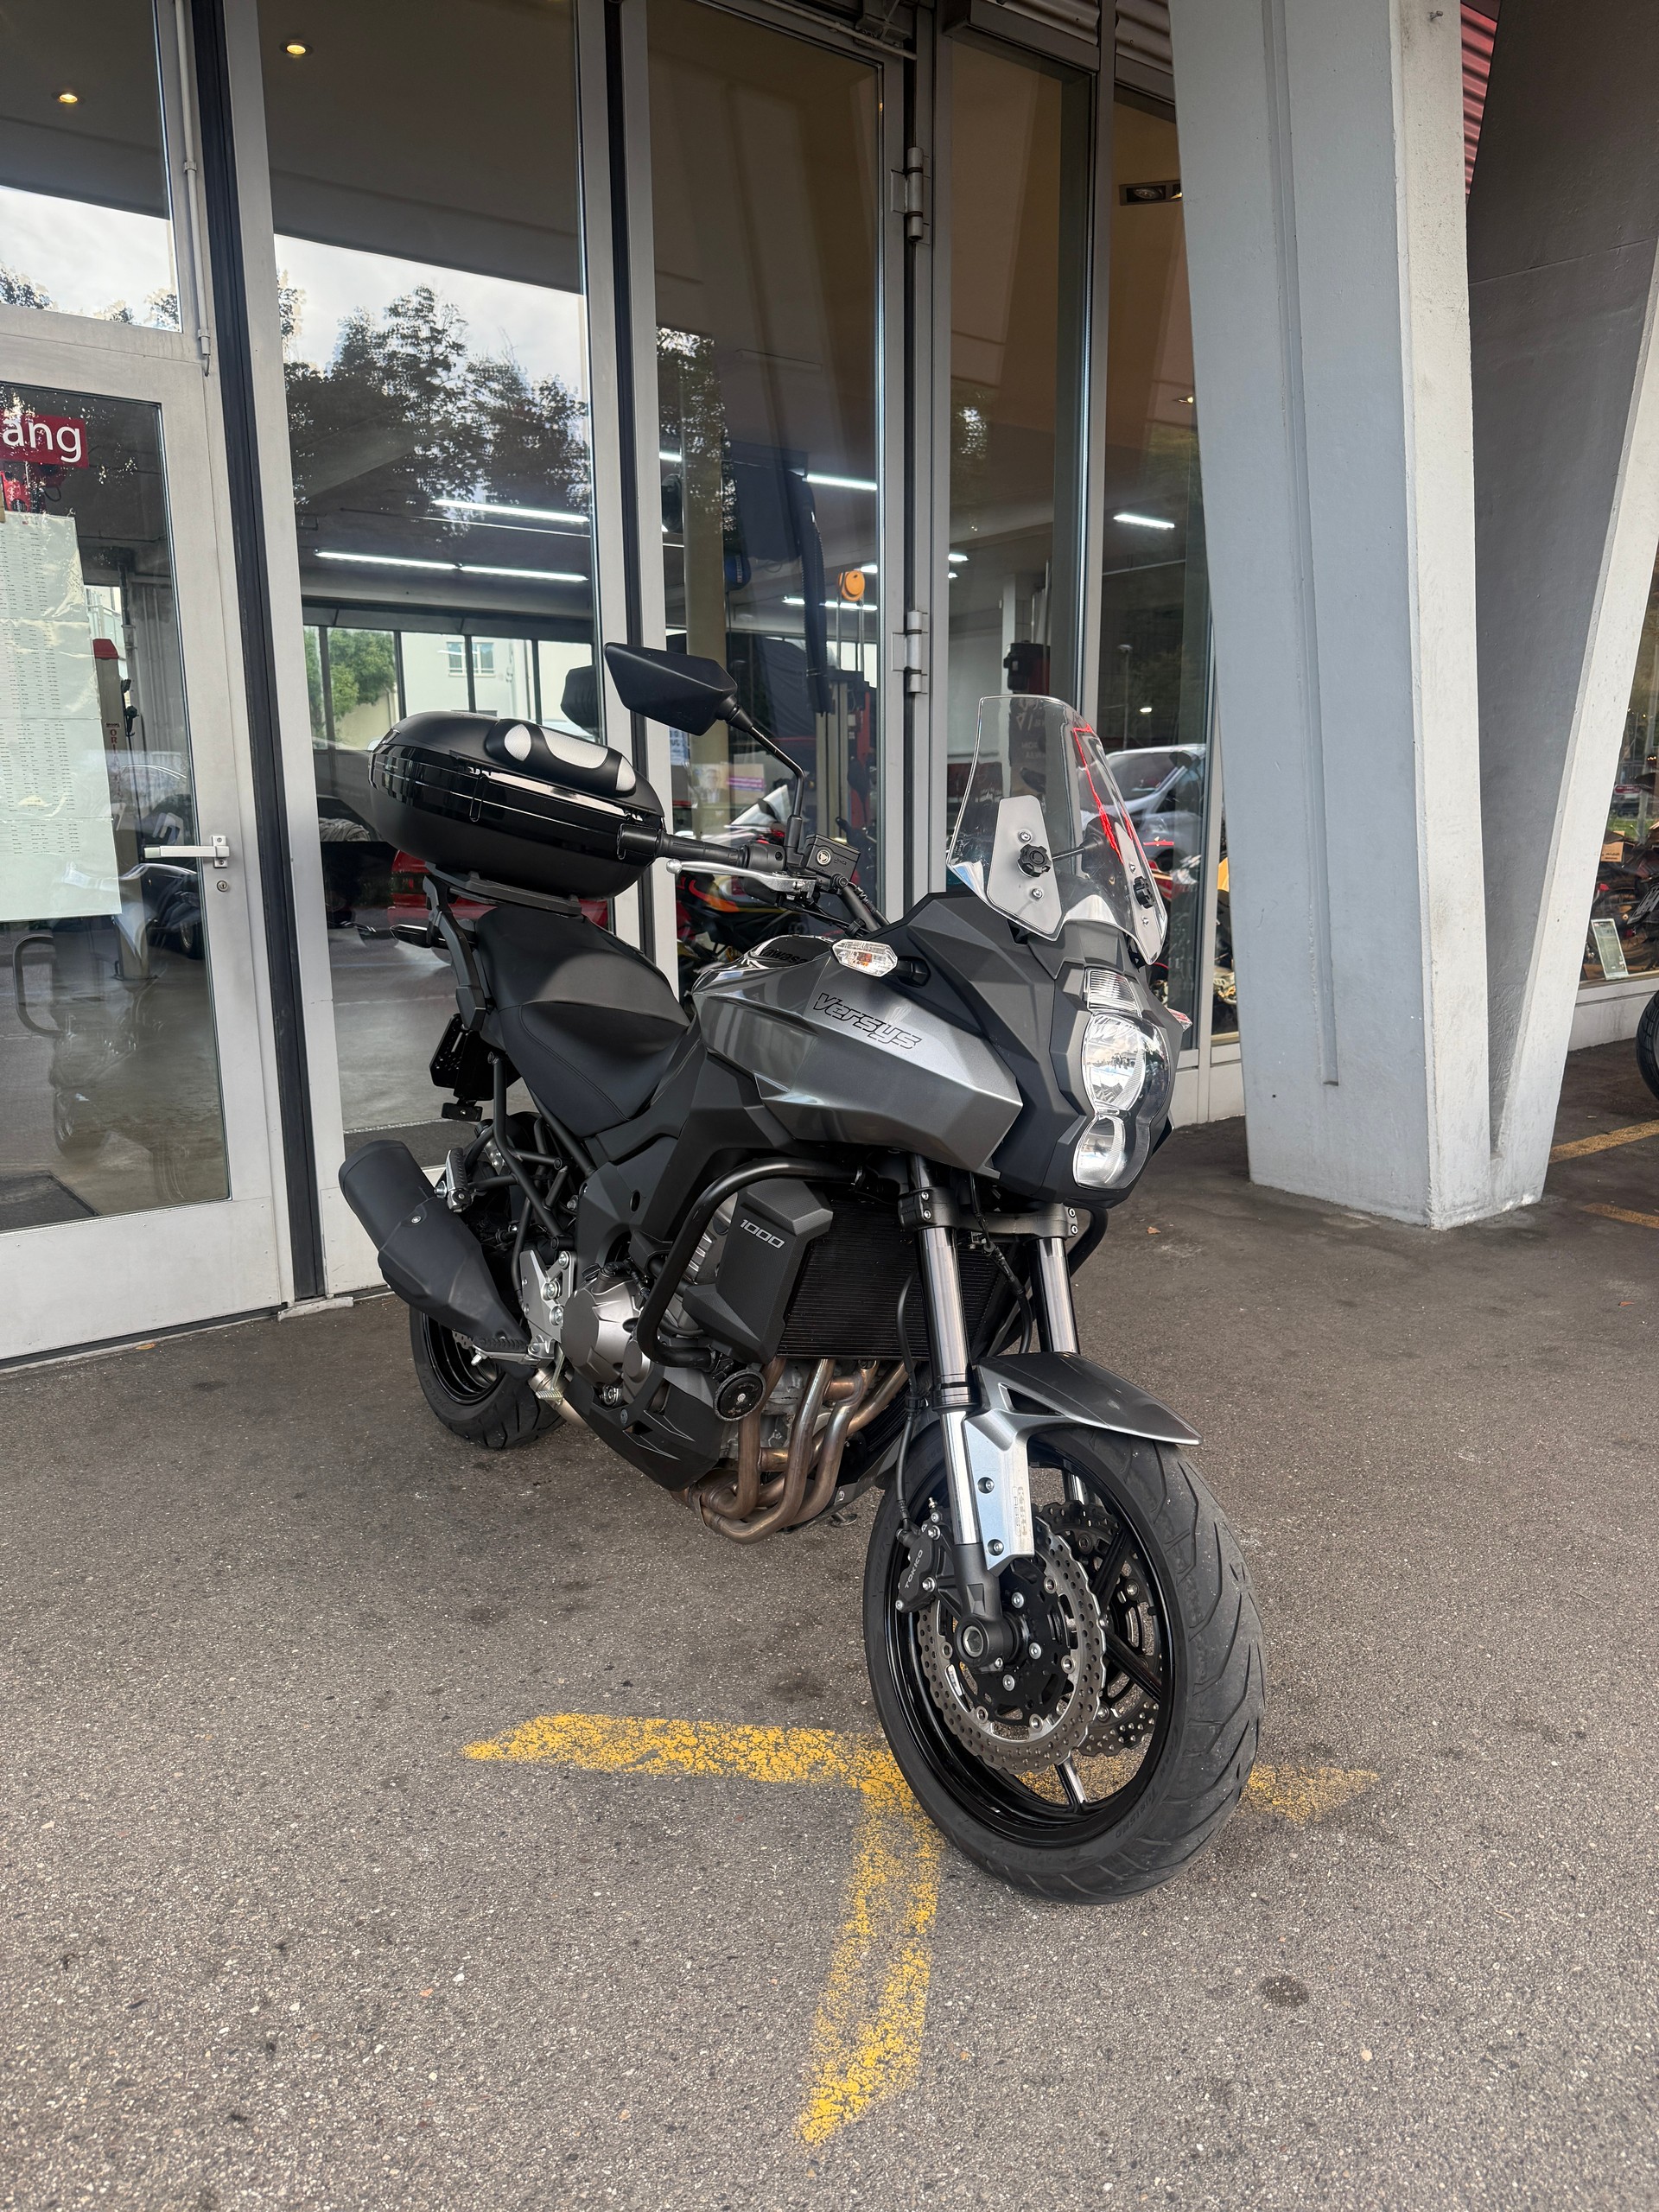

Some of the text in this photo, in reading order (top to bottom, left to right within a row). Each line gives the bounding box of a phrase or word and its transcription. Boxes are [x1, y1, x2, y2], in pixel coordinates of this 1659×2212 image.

[2, 417, 82, 463] ang
[812, 992, 923, 1050] Versys
[740, 1218, 785, 1249] 1000
[904, 1549, 924, 1589] TOKICO
